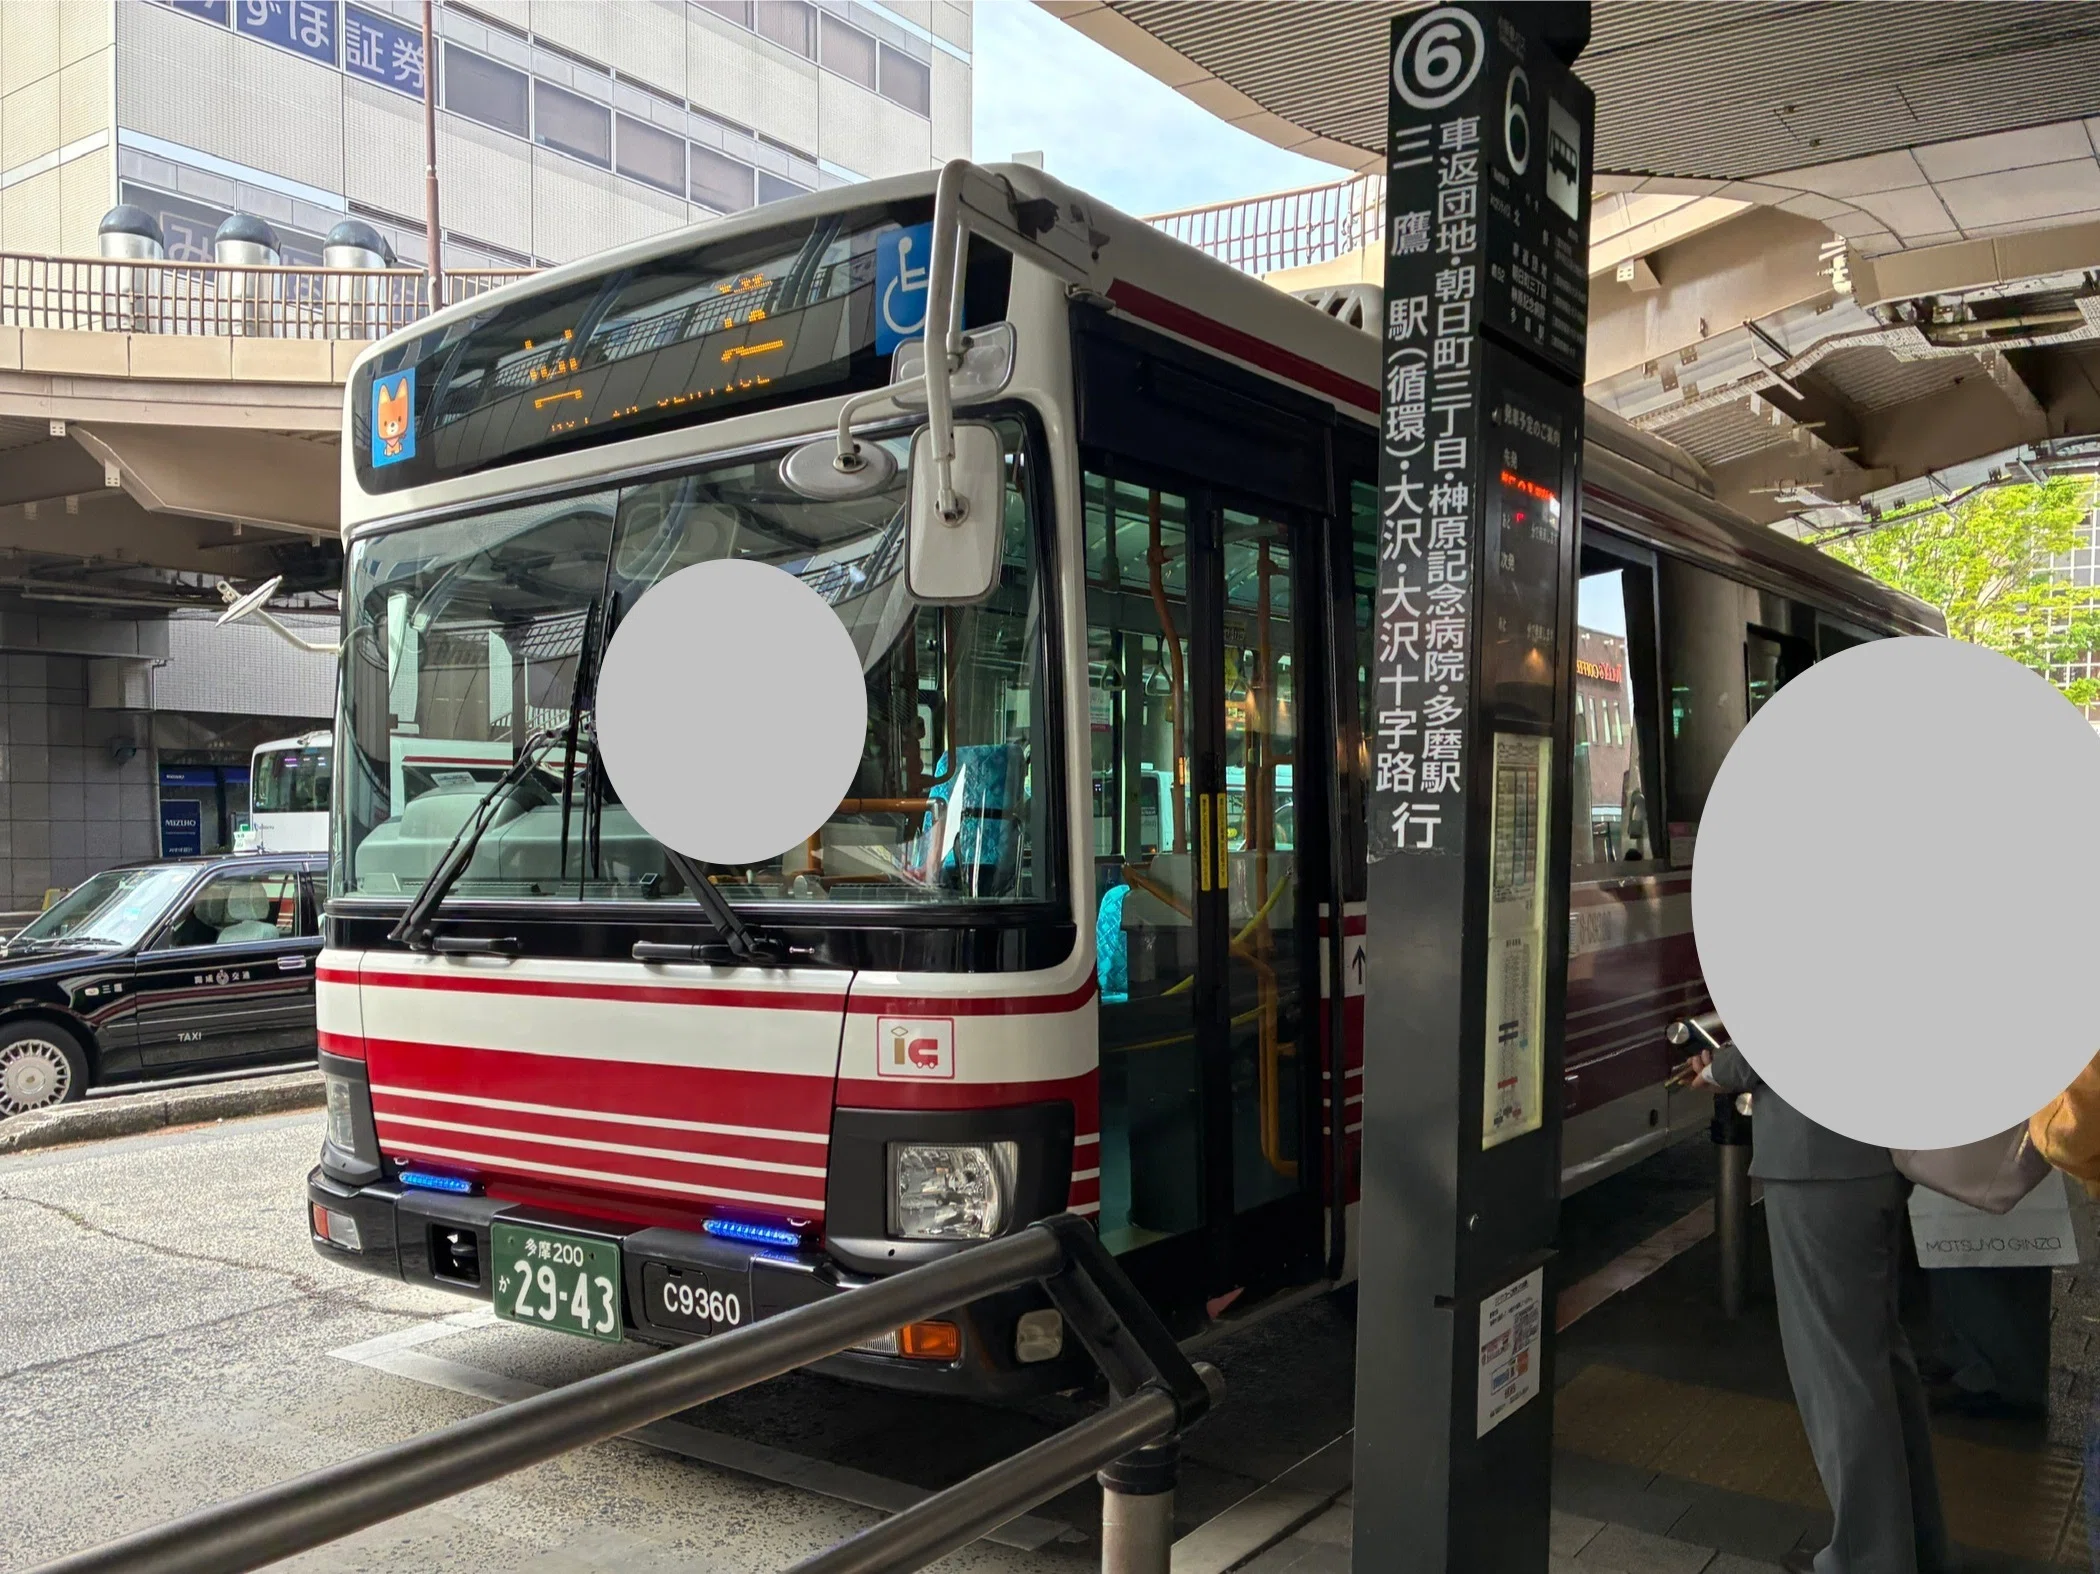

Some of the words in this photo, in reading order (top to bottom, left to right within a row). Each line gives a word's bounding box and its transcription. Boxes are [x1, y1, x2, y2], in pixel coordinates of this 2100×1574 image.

[204, 0, 425, 89] ずほ証券
[1505, 65, 1532, 177] 6
[165, 818, 196, 827] MIZUHO
[1392, 801, 1442, 850] 行
[178, 1031, 203, 1042] TAXI
[497, 1275, 511, 1295] か
[512, 1260, 616, 1334] 29-43
[662, 1283, 741, 1326] C9360
